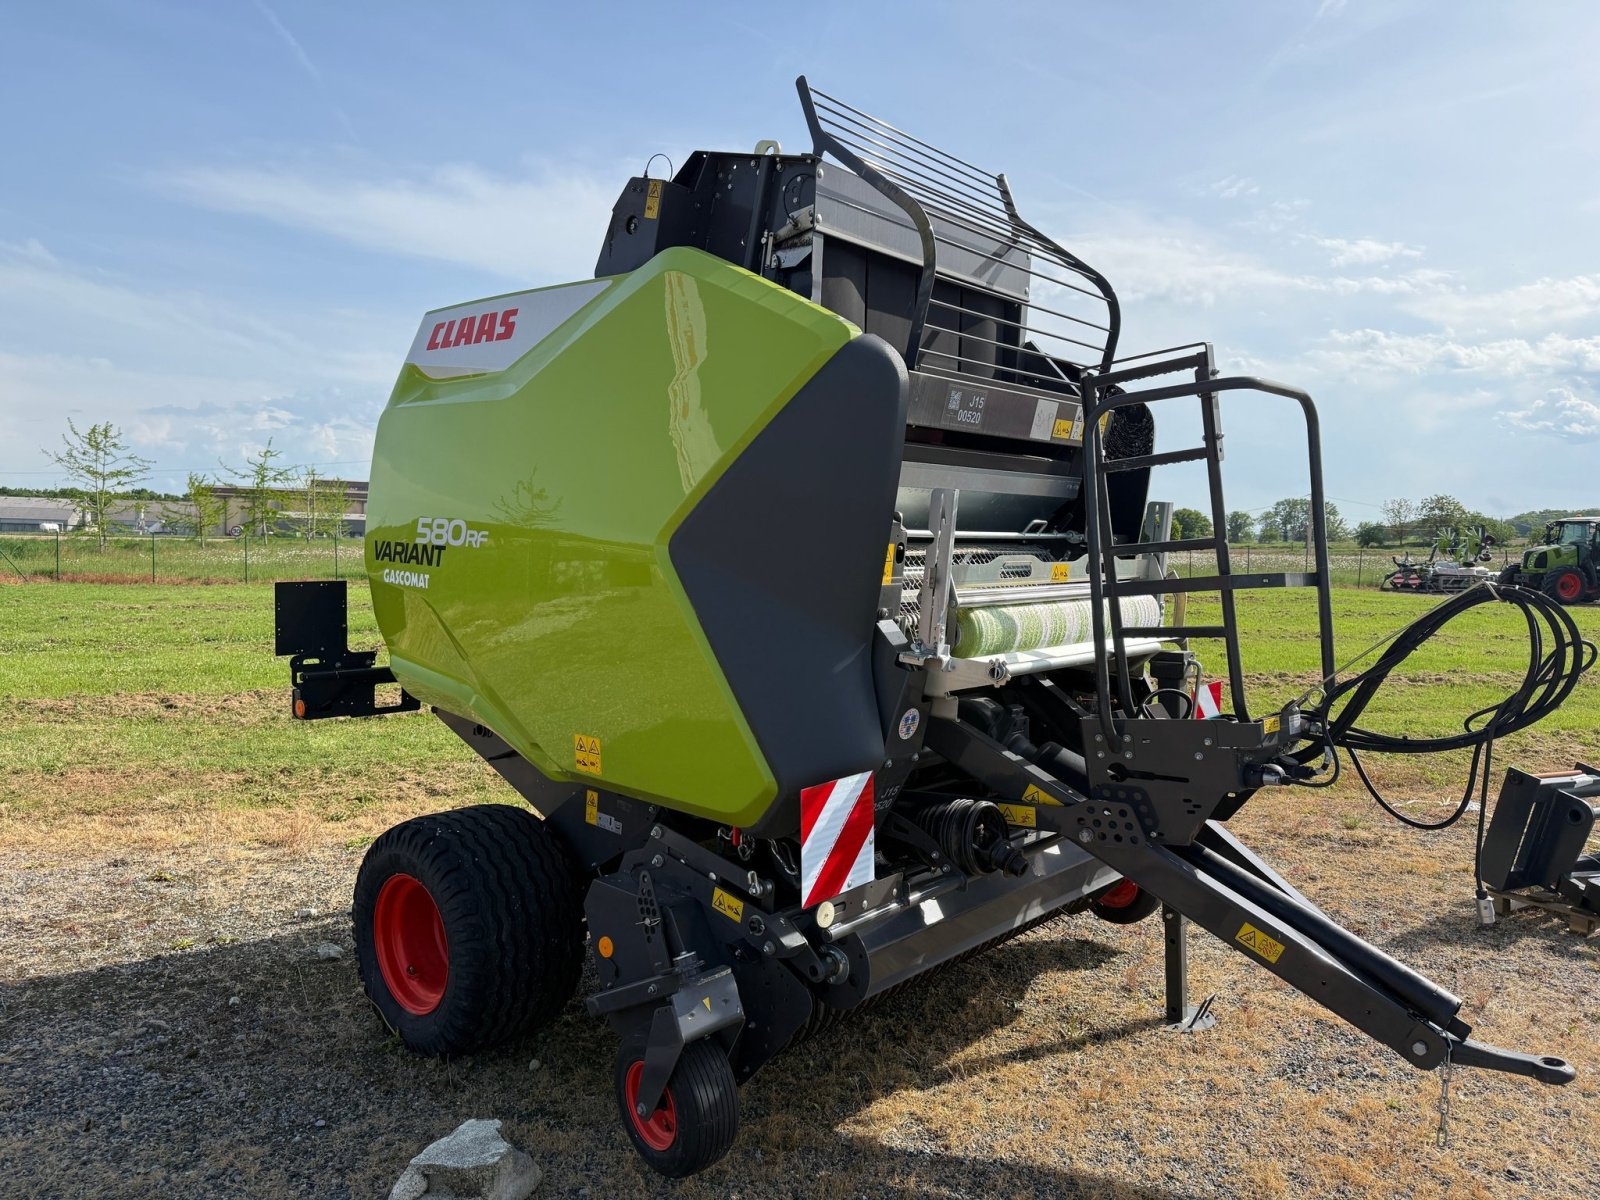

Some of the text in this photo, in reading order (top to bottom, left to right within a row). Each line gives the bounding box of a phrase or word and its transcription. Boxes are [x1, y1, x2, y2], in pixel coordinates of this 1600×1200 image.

[426, 308, 519, 351] CLAAS
[969, 395, 985, 409] J15
[957, 409, 981, 424] 00520
[374, 540, 447, 567] VARIANT
[383, 568, 430, 589] GASCOMAT
[880, 785, 900, 799] J15
